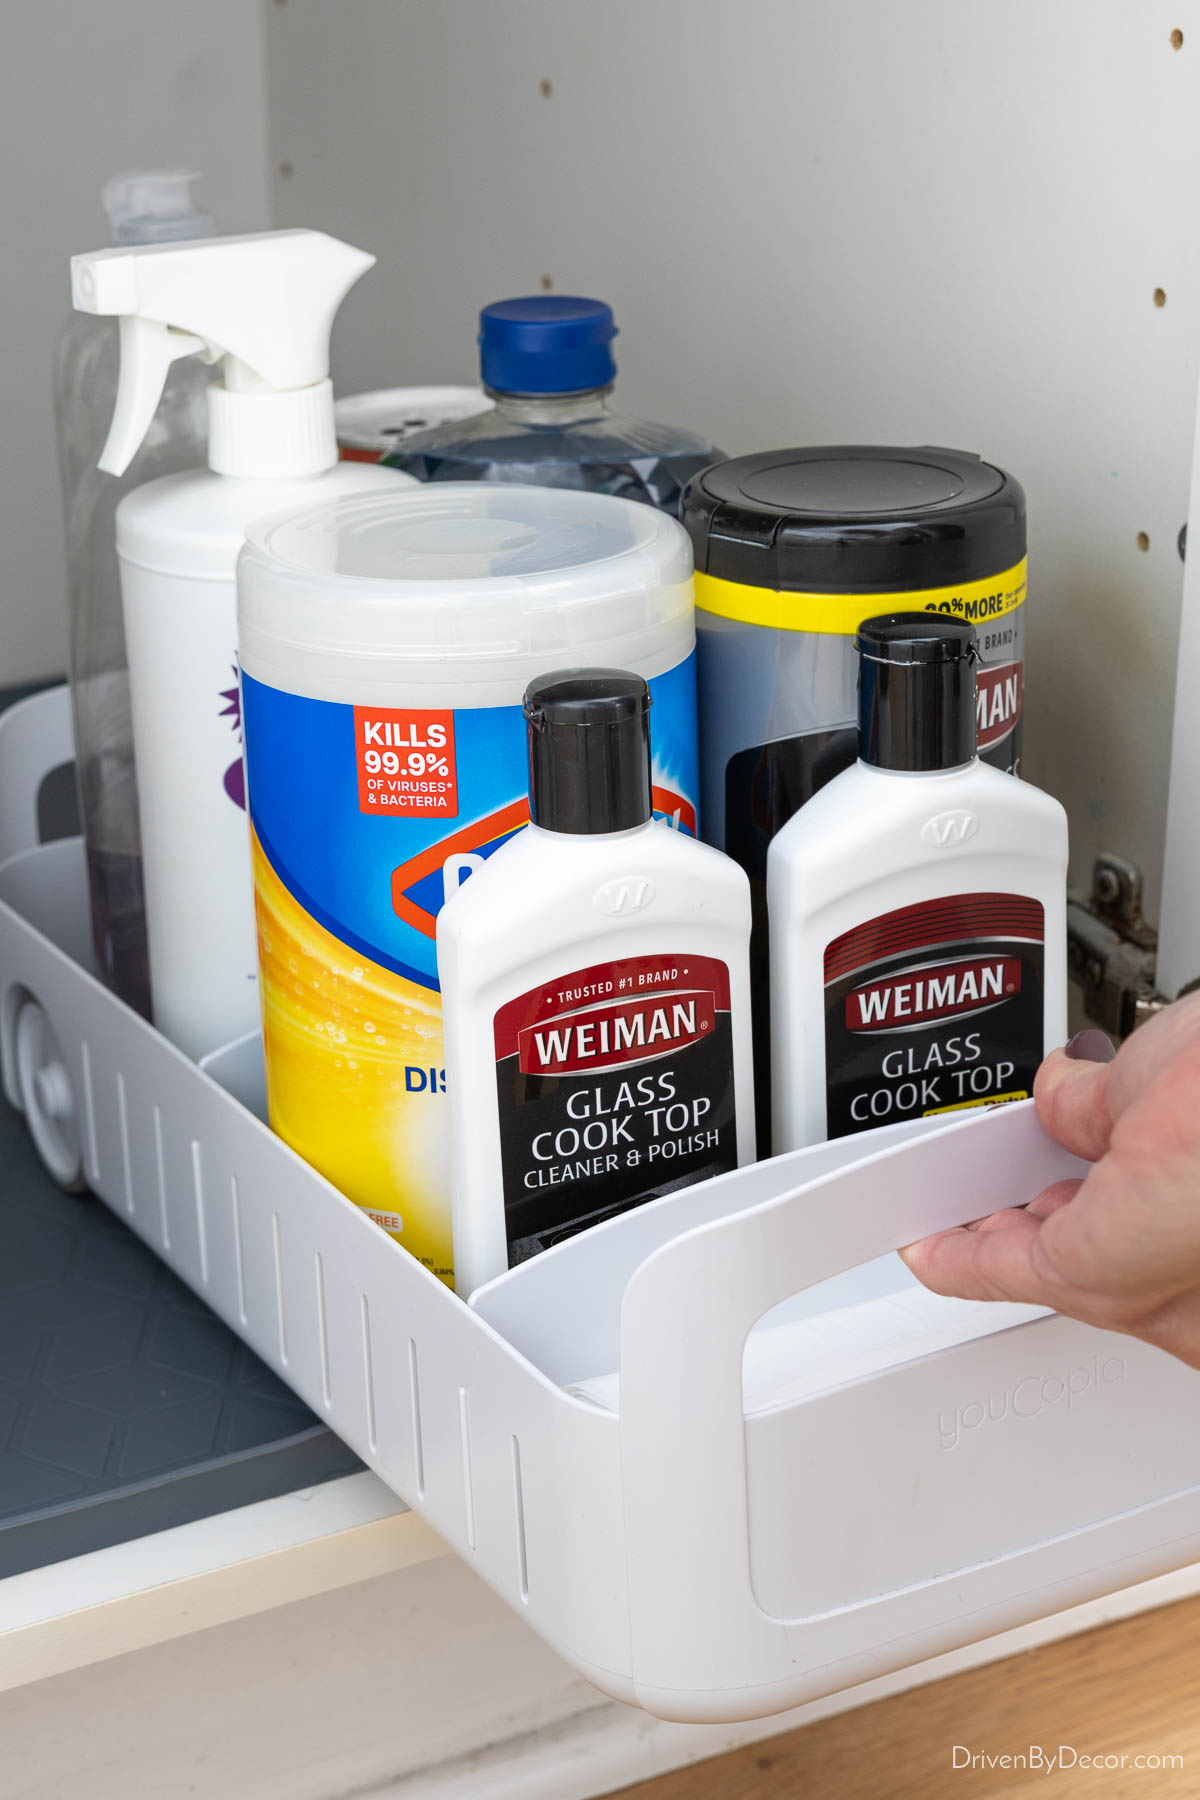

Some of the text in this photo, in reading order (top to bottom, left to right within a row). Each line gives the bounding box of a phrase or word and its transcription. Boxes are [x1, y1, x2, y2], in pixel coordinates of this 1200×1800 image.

[985, 629, 1013, 650] BRAND
[364, 721, 447, 748] KILLS
[364, 750, 449, 777] 99.9%
[367, 779, 384, 790] OF
[368, 793, 448, 807] & BACTERIA
[558, 968, 678, 1004] TRUSTED #1 BRAND
[858, 964, 1004, 1024] WEIMAN
[534, 1000, 697, 1066] WEIMAN
[881, 1033, 981, 1079] GLASS
[566, 1071, 676, 1119] GLASS
[850, 1076, 942, 1121] COOK
[951, 1061, 1015, 1097] TOP
[531, 1097, 711, 1161] COOK TOP
[524, 1129, 719, 1189] CLEANER & POLISH
[938, 1352, 1127, 1450] youCopia
